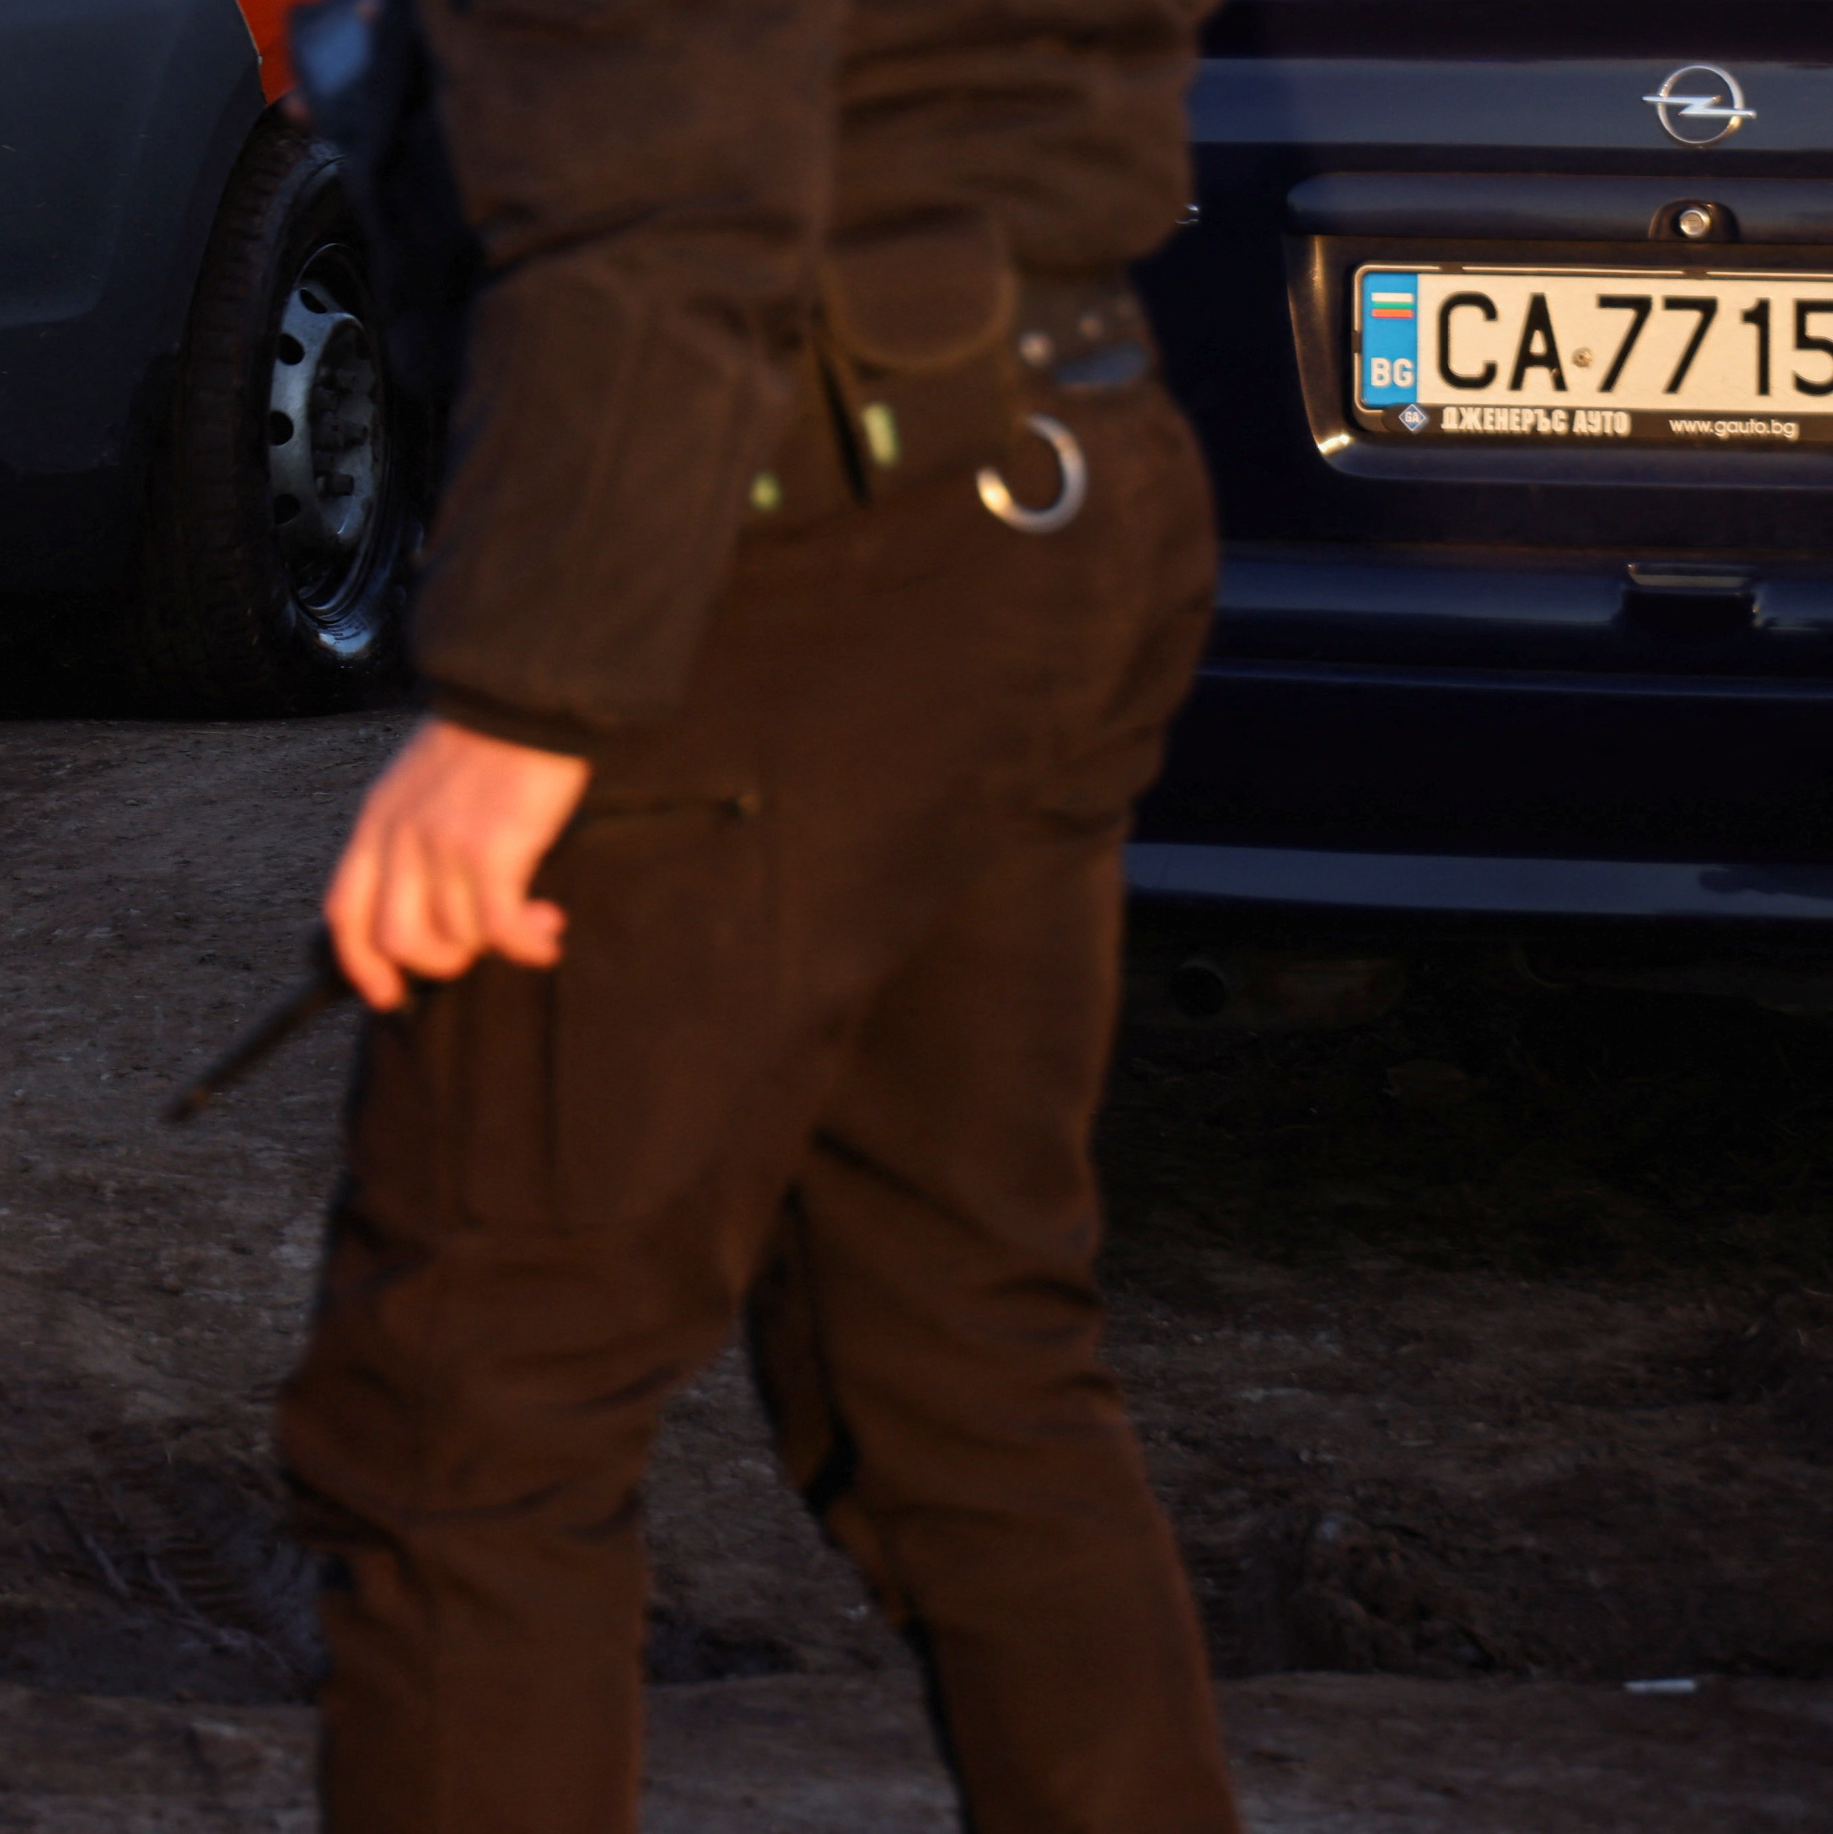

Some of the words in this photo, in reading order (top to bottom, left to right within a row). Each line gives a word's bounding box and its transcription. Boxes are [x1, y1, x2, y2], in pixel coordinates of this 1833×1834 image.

[1438, 291, 1568, 393] CA
[1597, 293, 1833, 397] 7715
[1370, 356, 1415, 388] BG
[1572, 409, 1632, 436] АУТО
[1669, 417, 1800, 441] www.gauto.bg
